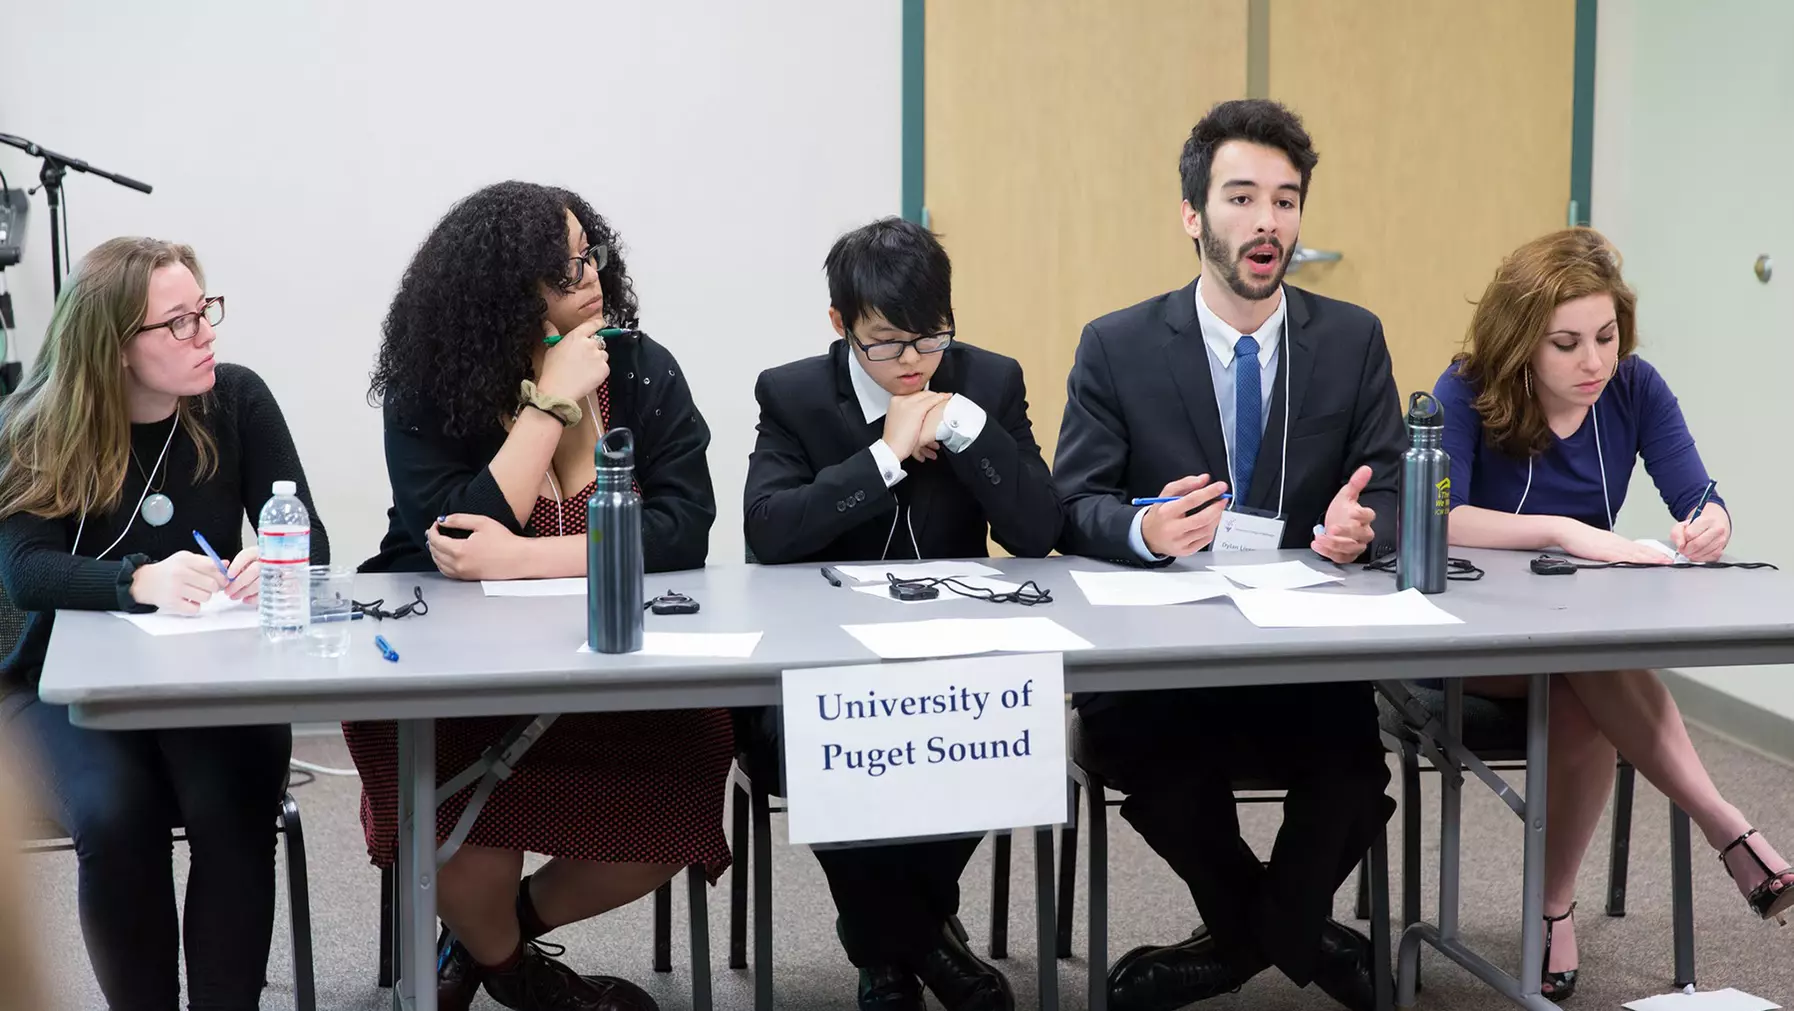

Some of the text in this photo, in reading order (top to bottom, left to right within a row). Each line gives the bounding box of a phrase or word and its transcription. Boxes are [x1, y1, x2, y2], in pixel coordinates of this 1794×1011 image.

[817, 679, 1033, 721] University of
[821, 728, 1032, 777] Puget Sound
